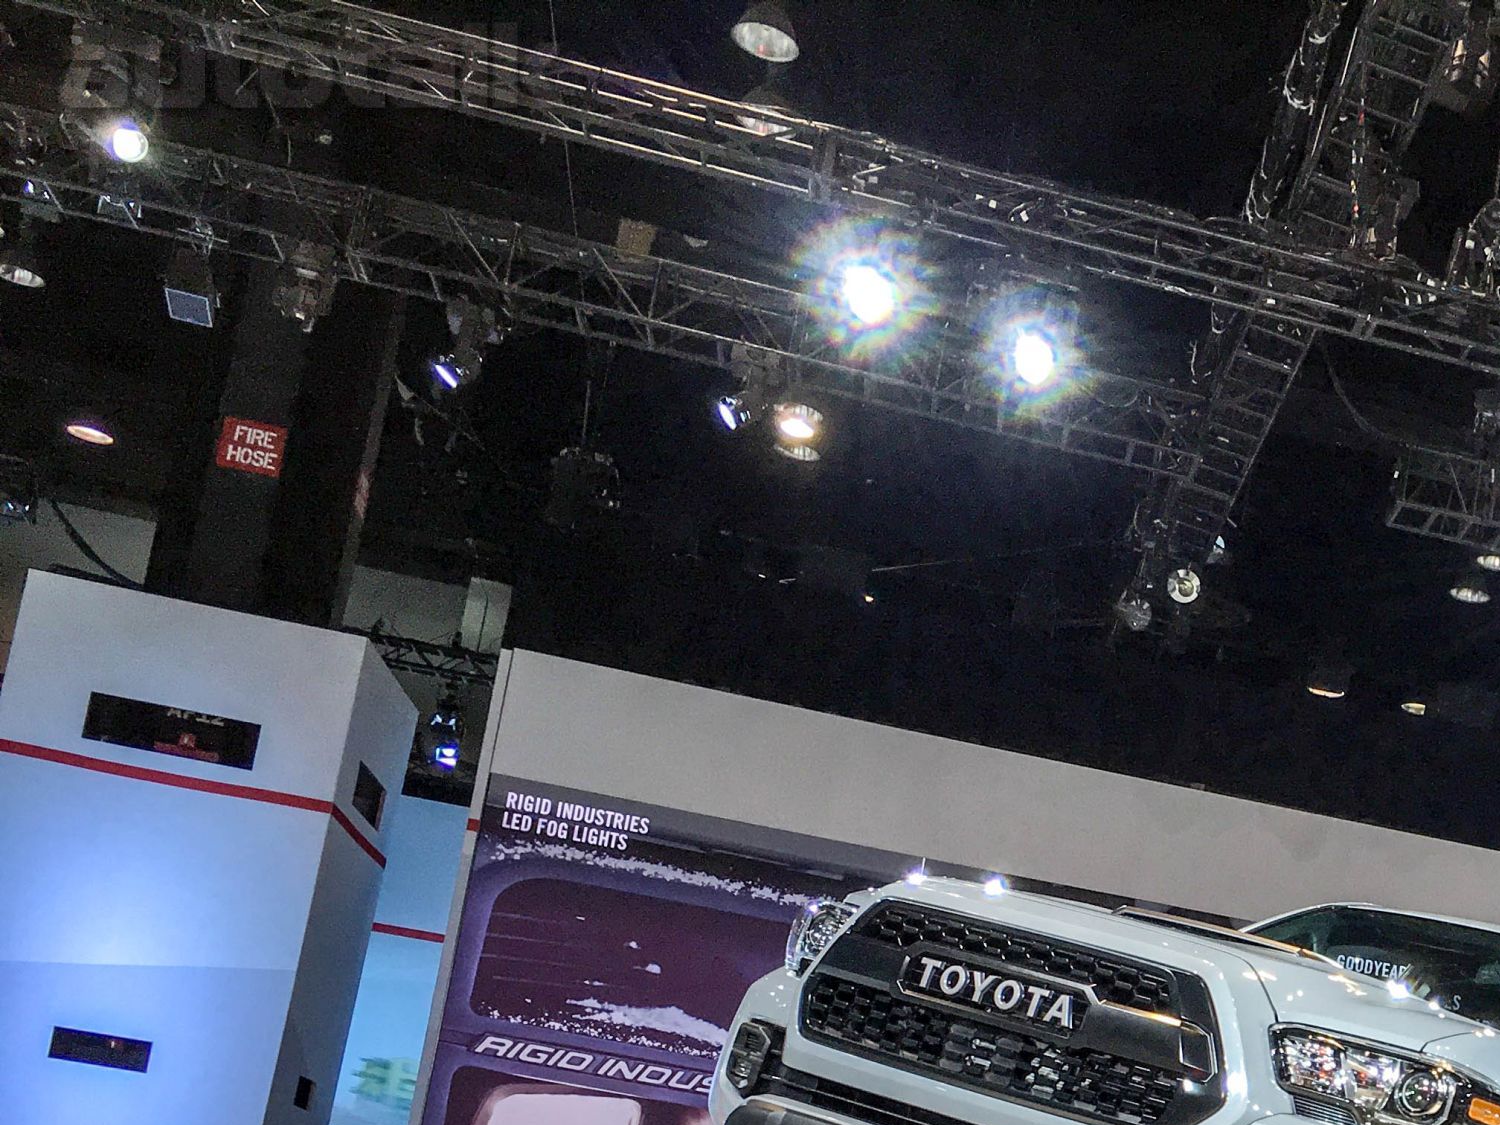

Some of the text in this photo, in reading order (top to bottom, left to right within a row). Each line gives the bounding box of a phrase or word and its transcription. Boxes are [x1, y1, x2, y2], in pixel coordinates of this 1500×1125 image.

[234, 425, 278, 449] FIRE
[226, 444, 279, 471] HOSE
[501, 811, 628, 850] LED FOG LIGHTS
[505, 791, 650, 834] RIGID INDUSTRIES
[918, 956, 1074, 1029] TOYOTA
[474, 1036, 593, 1071] RIGID
